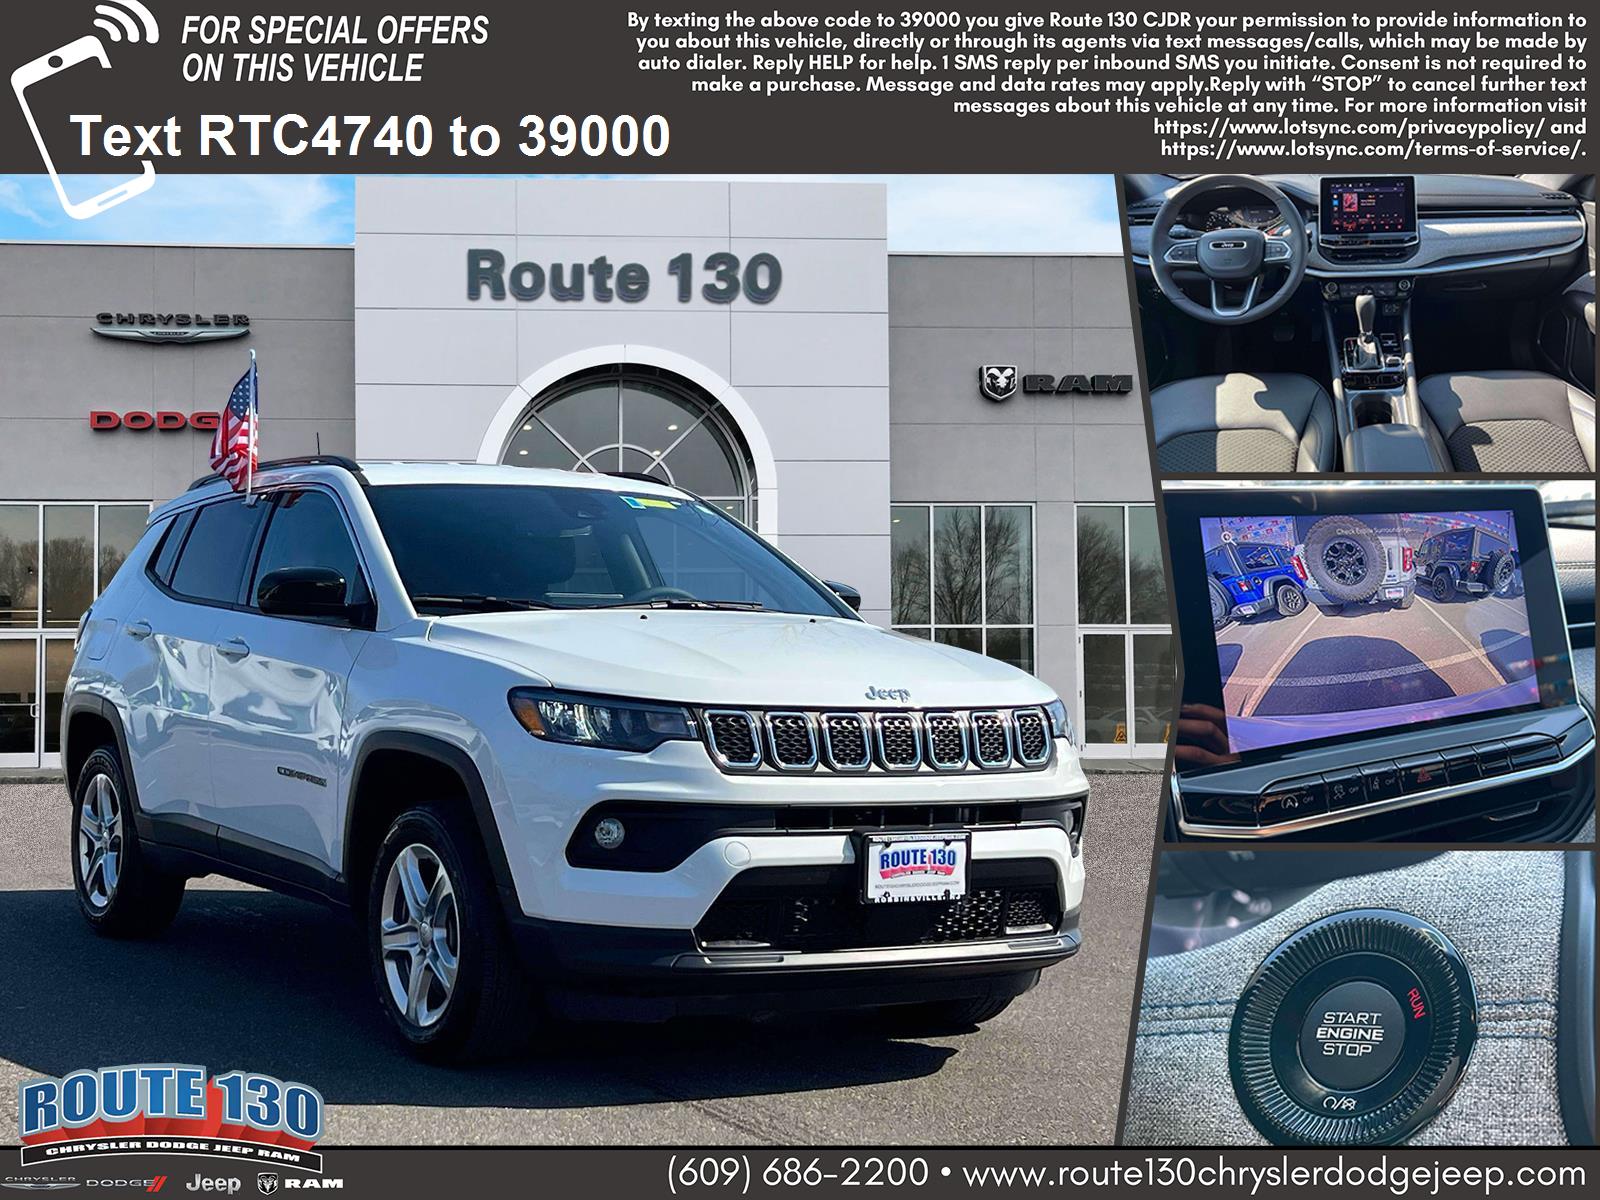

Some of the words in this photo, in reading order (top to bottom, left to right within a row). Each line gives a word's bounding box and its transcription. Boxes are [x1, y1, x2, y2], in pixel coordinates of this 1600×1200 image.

[467, 249, 650, 303] Route
[667, 252, 782, 304] 130
[96, 312, 250, 326] CHRYSLER
[1023, 374, 1133, 394] RAM
[90, 411, 220, 430] DODG
[865, 686, 911, 703] Jeep
[880, 849, 927, 869] ROUTE
[930, 849, 956, 866] 130
[1407, 988, 1426, 1019] RUN
[1323, 1012, 1382, 1025] START
[1316, 1028, 1384, 1041] ENGINE
[1323, 1043, 1372, 1057] STOP
